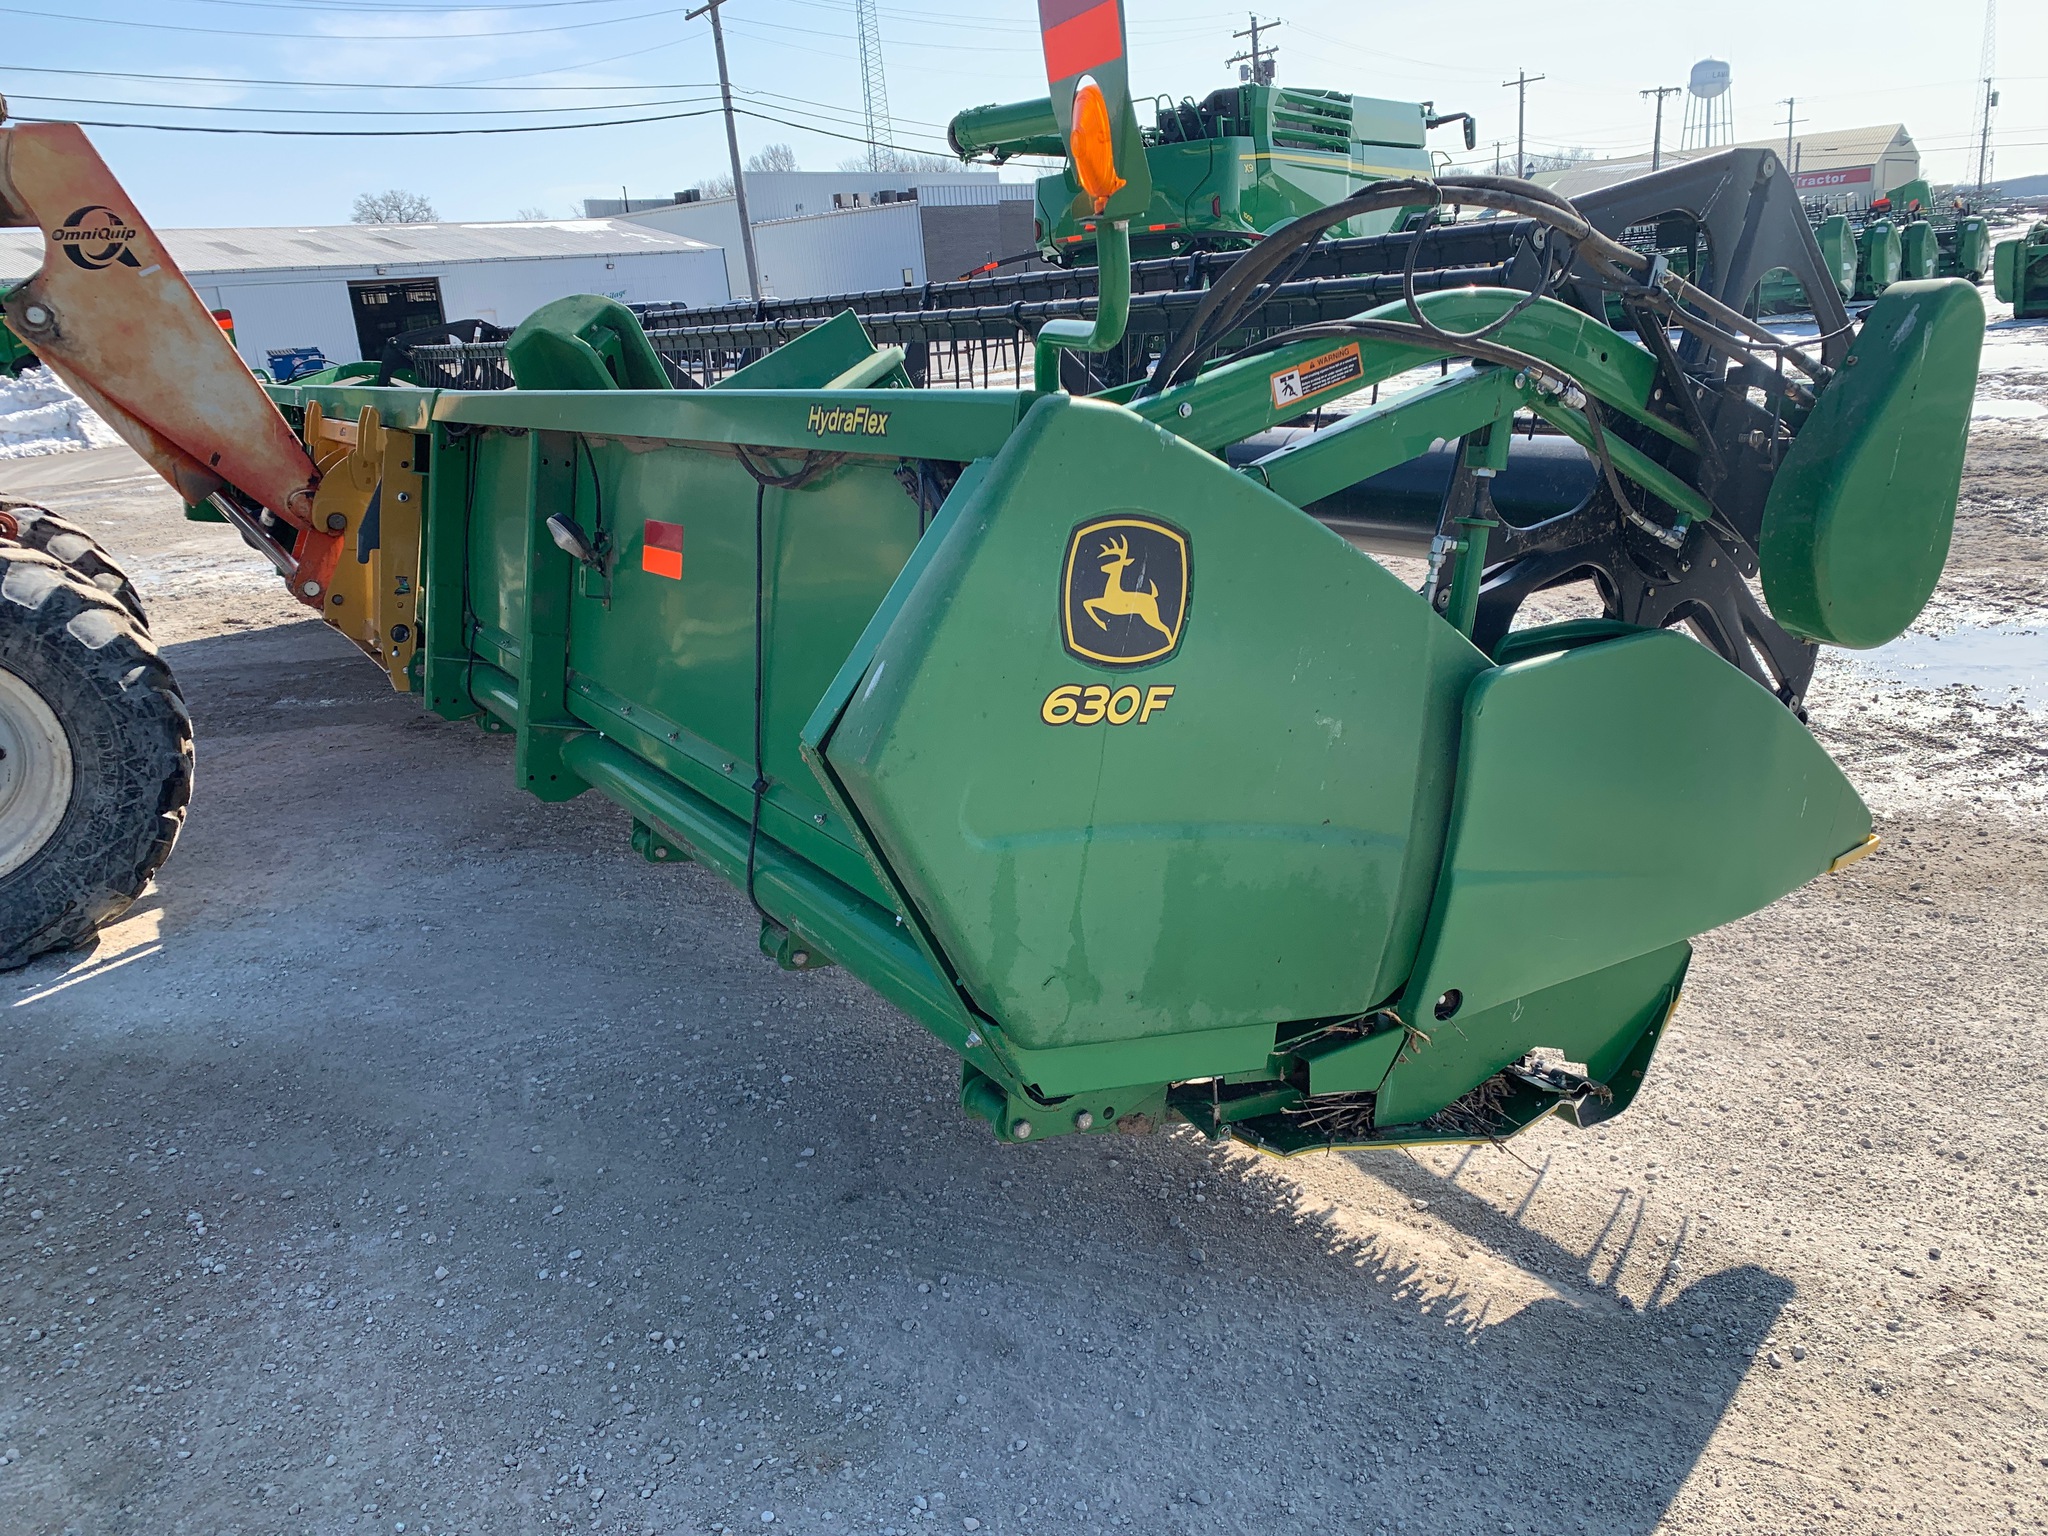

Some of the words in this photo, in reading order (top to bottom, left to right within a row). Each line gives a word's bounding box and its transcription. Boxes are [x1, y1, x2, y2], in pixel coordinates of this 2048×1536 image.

[1243, 163, 1254, 174] X9
[1796, 173, 1847, 187] Tractor
[52, 227, 136, 242] OmniQuip
[1316, 347, 1350, 366] WARNING
[807, 403, 891, 438] HydraFlex
[1040, 683, 1177, 727] 630F
